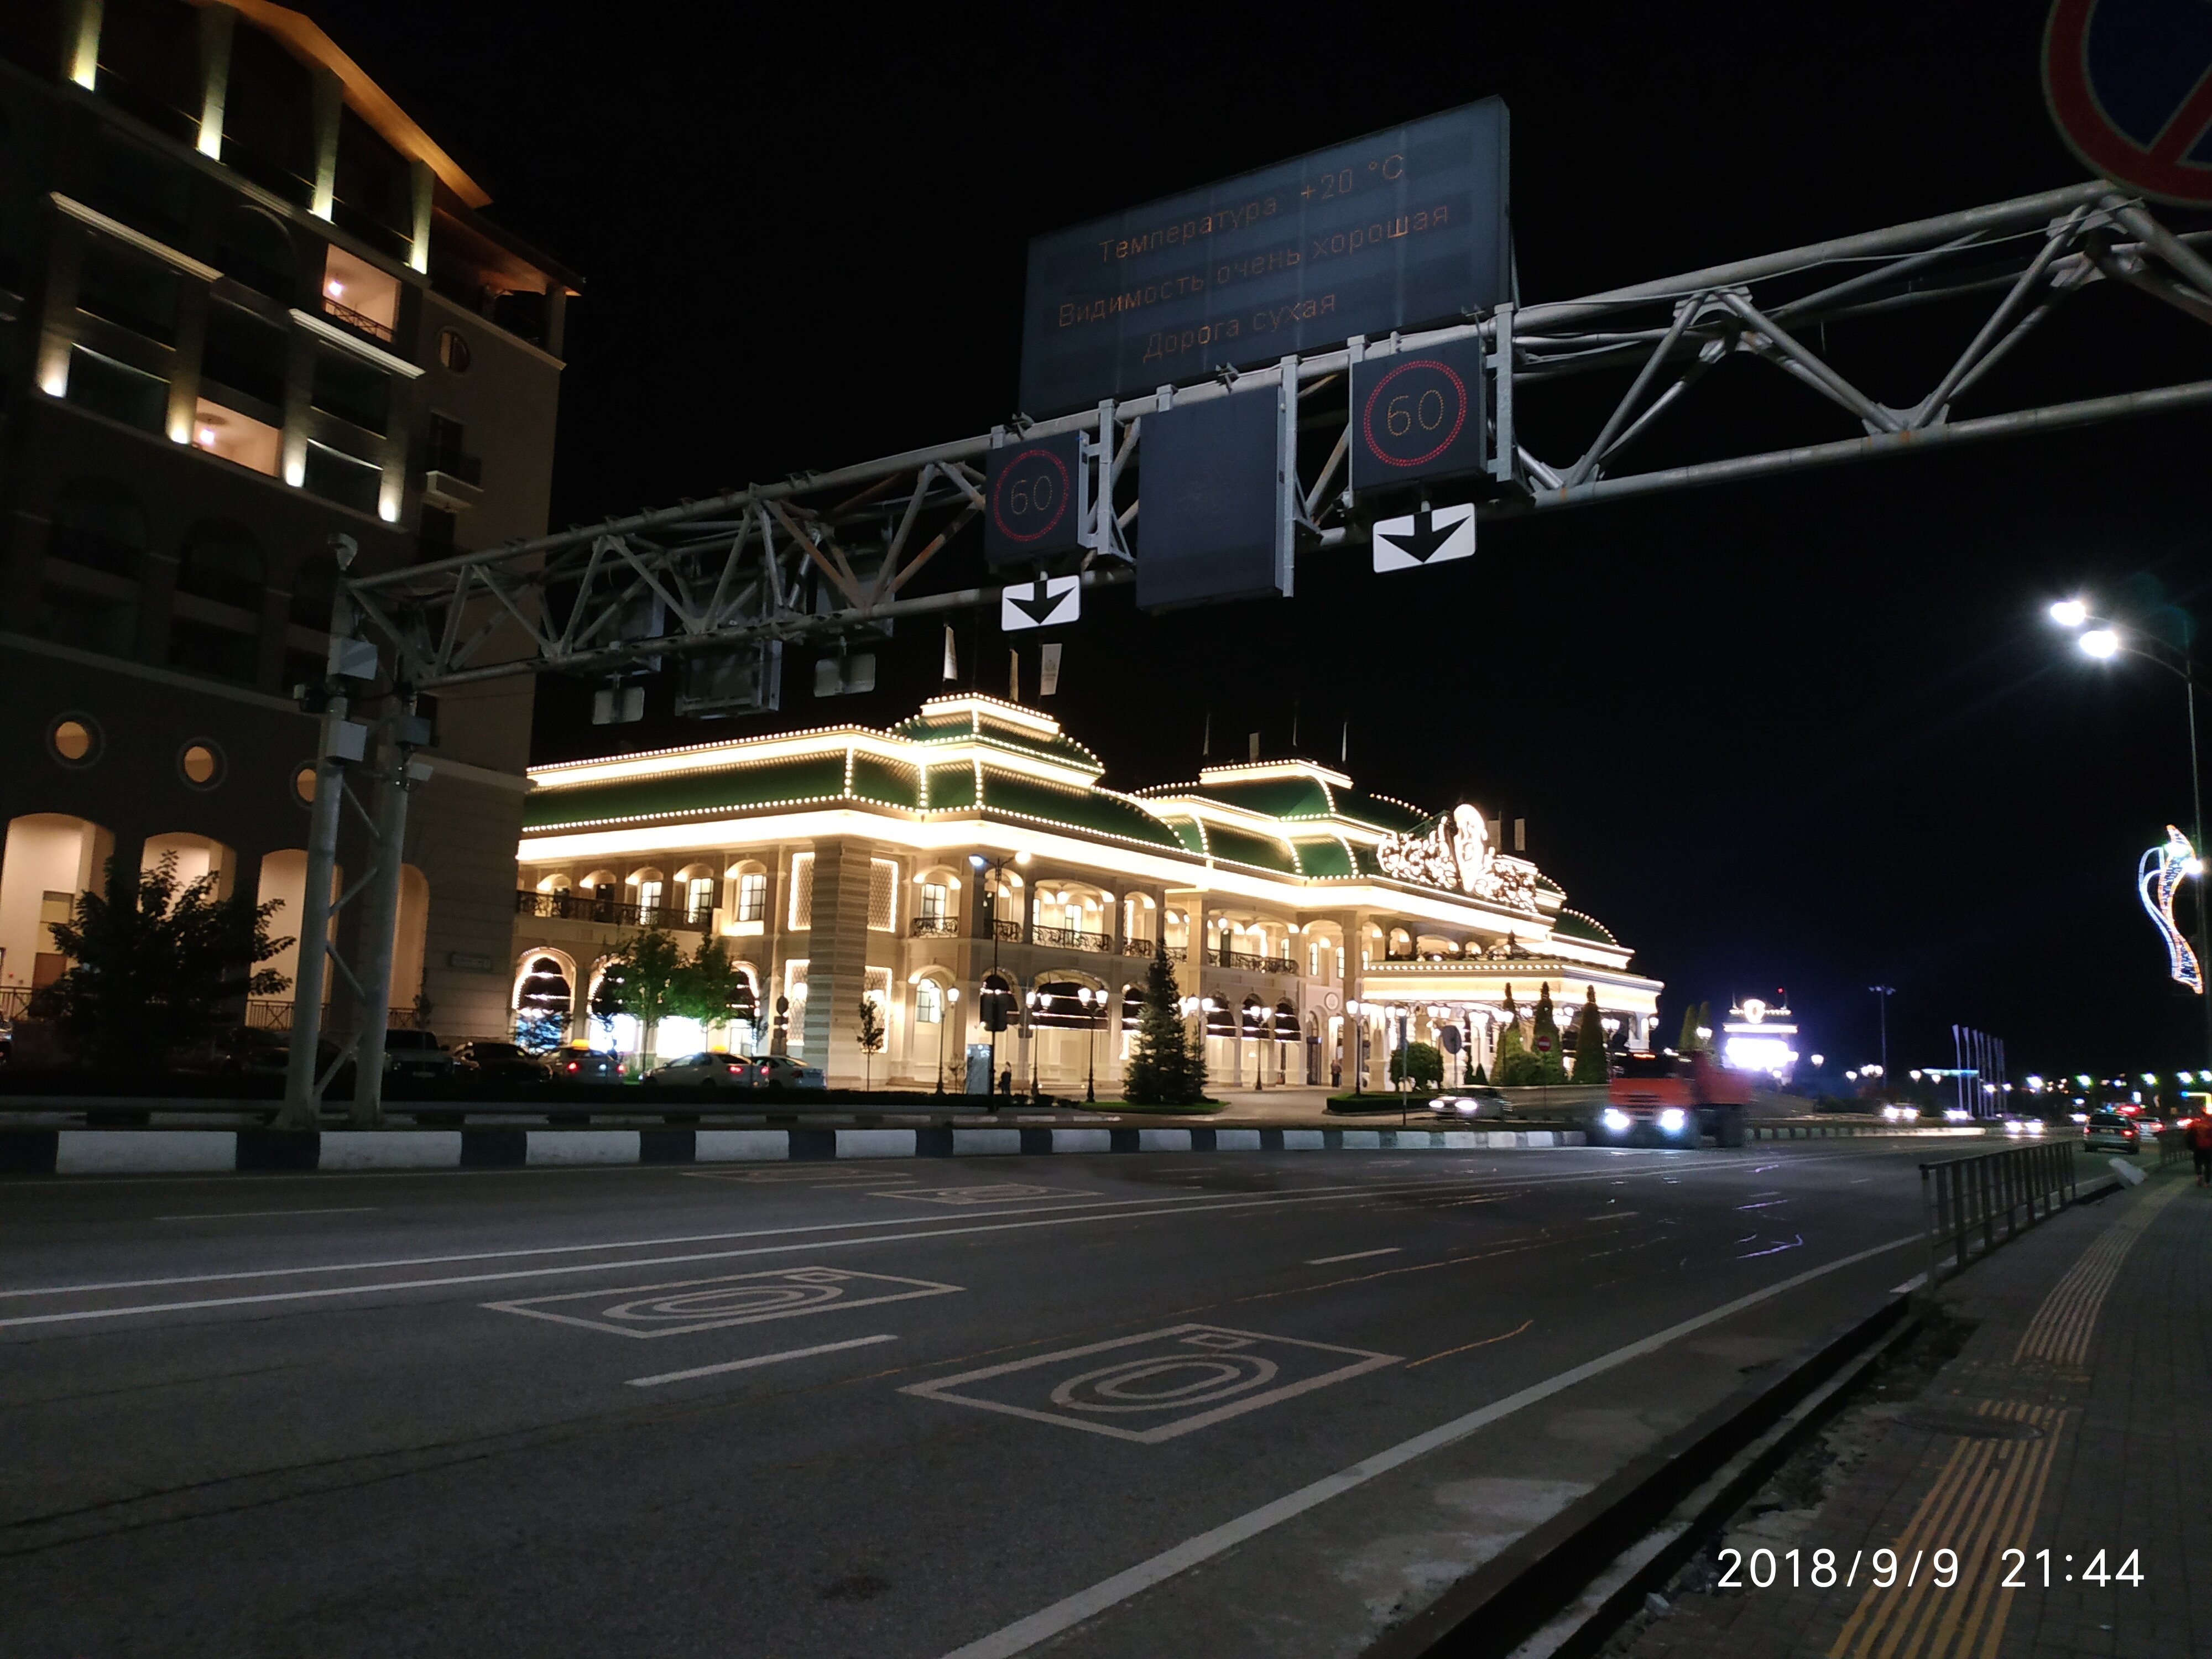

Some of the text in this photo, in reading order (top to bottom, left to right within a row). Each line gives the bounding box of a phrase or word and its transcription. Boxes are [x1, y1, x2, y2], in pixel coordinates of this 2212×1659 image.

[1098, 196, 1279, 263] Температура
[1300, 167, 1353, 202] +20
[1058, 204, 1449, 328] Видимость очень хорошая
[1142, 293, 1337, 364] Дорога сухая
[1386, 389, 1444, 437] 60
[1010, 474, 1053, 516] 60
